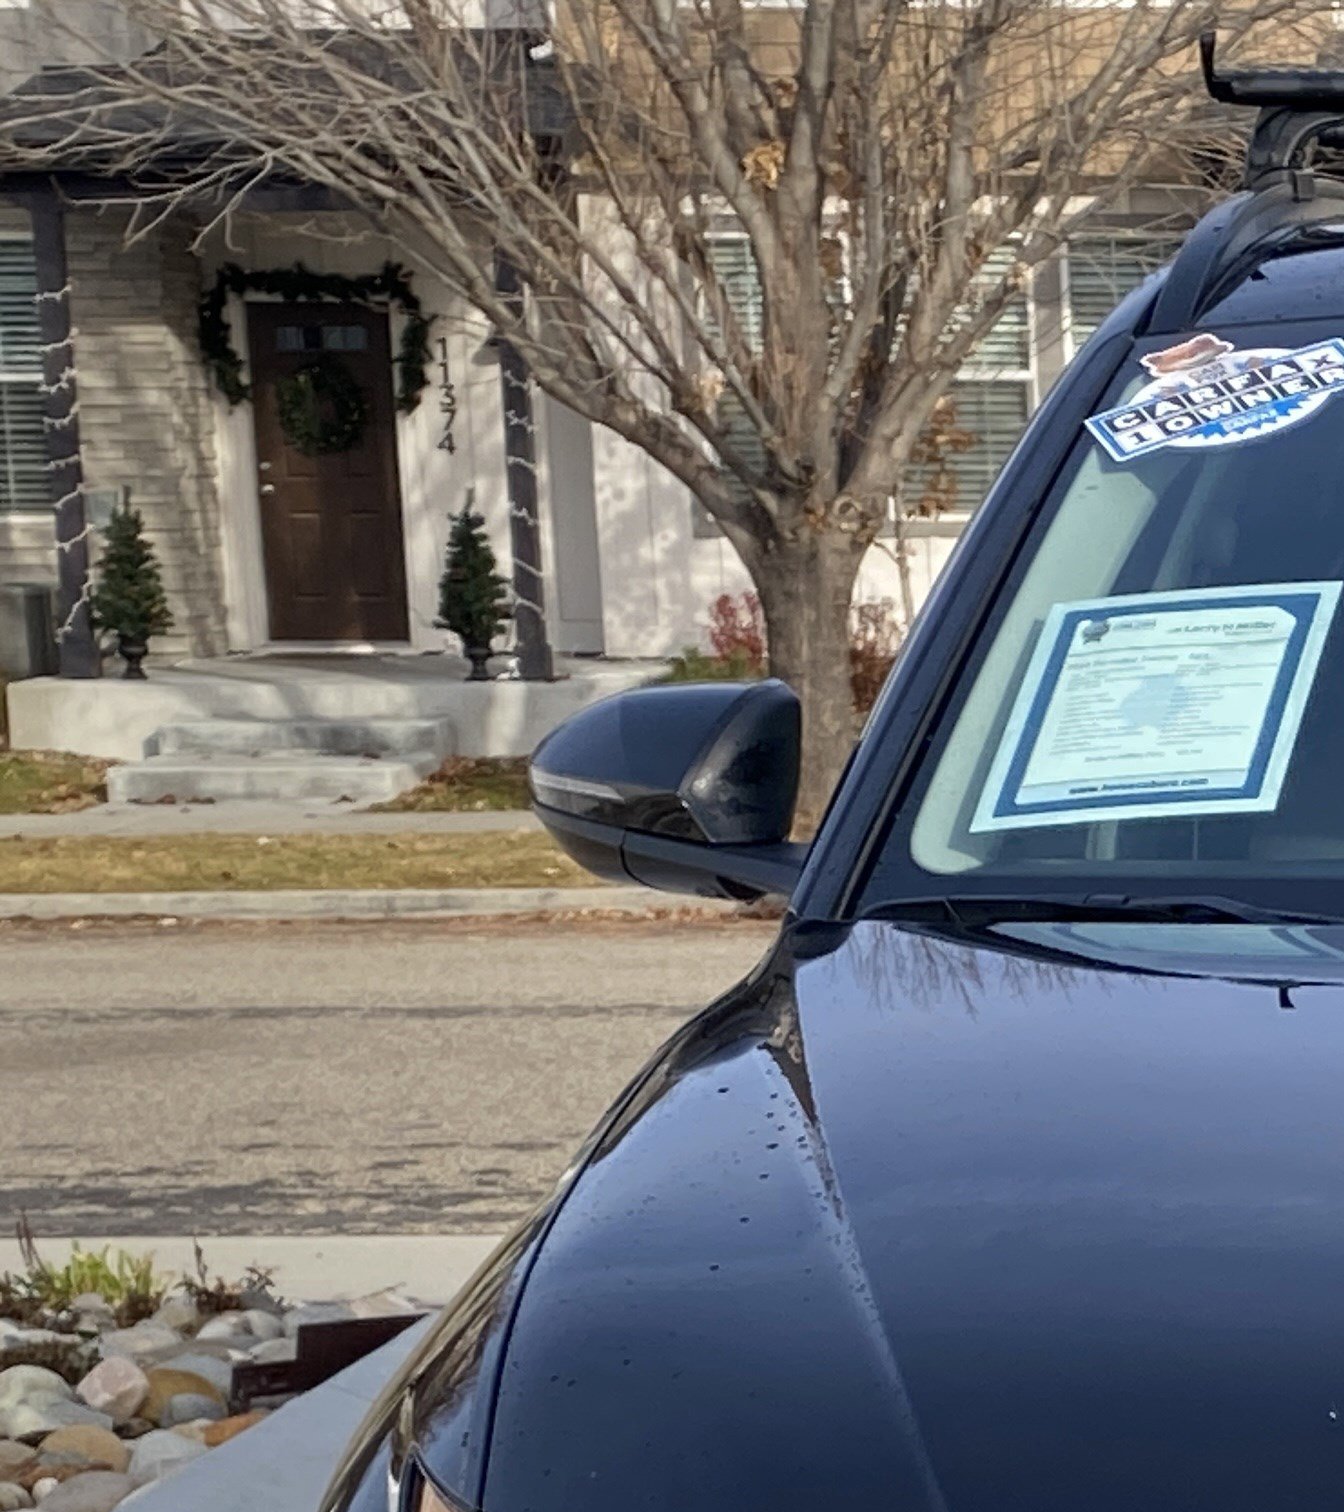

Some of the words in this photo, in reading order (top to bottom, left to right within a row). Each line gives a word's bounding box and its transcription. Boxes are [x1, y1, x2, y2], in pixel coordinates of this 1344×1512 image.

[434, 337, 457, 455] 11374
[1112, 354, 1335, 431] CARFAX
[1124, 430, 1153, 446] 1
